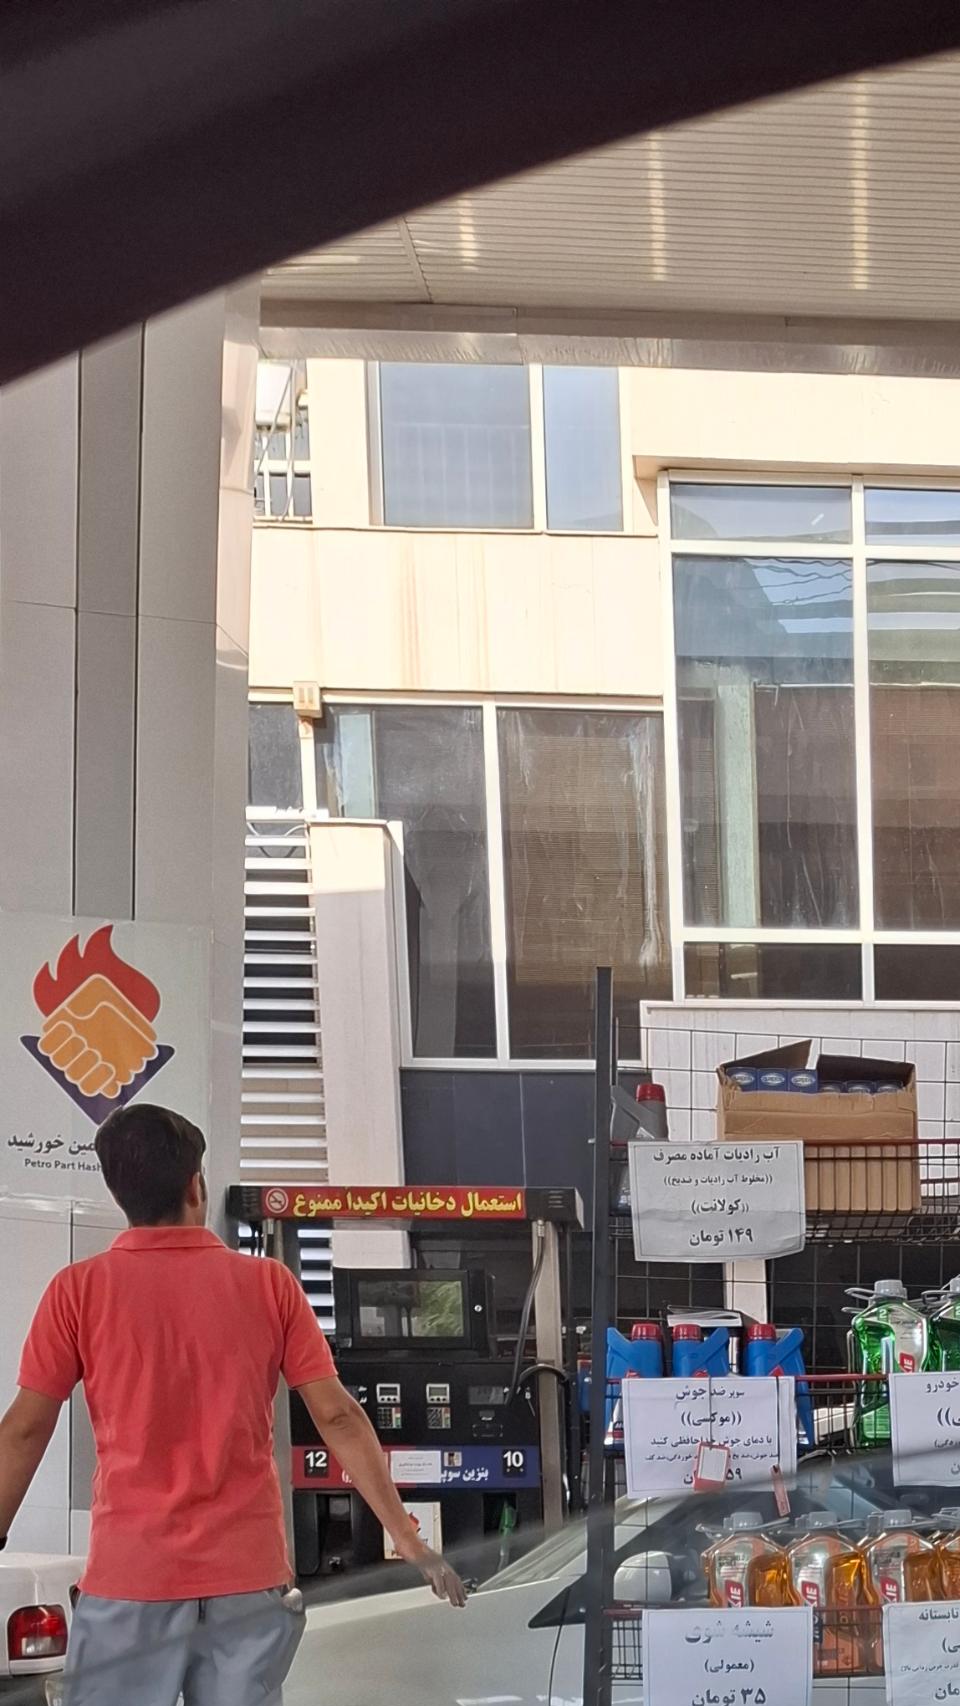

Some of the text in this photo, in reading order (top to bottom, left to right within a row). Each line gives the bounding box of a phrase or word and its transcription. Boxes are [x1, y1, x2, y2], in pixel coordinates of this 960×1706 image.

[8, 1132, 96, 1155] مین خورشید
[653, 1146, 780, 1165] آب رادیات آماده مصرف
[24, 1158, 102, 1171] Petro Part Hash
[293, 1193, 342, 1217] ممنوع
[391, 1191, 456, 1216] دخانیات
[461, 1191, 522, 1217] استعمال
[690, 1227, 754, 1246] ۱۴۹ تومان
[675, 1385, 707, 1401] جوش
[925, 1379, 959, 1394] خودرو
[305, 1450, 327, 1467] 12
[503, 1450, 524, 1467] 10
[462, 1467, 489, 1482] بنزین
[918, 1607, 960, 1623] تابستانه
[704, 1659, 755, 1673] (معمولی)
[740, 1687, 767, 1705] ۳۵
